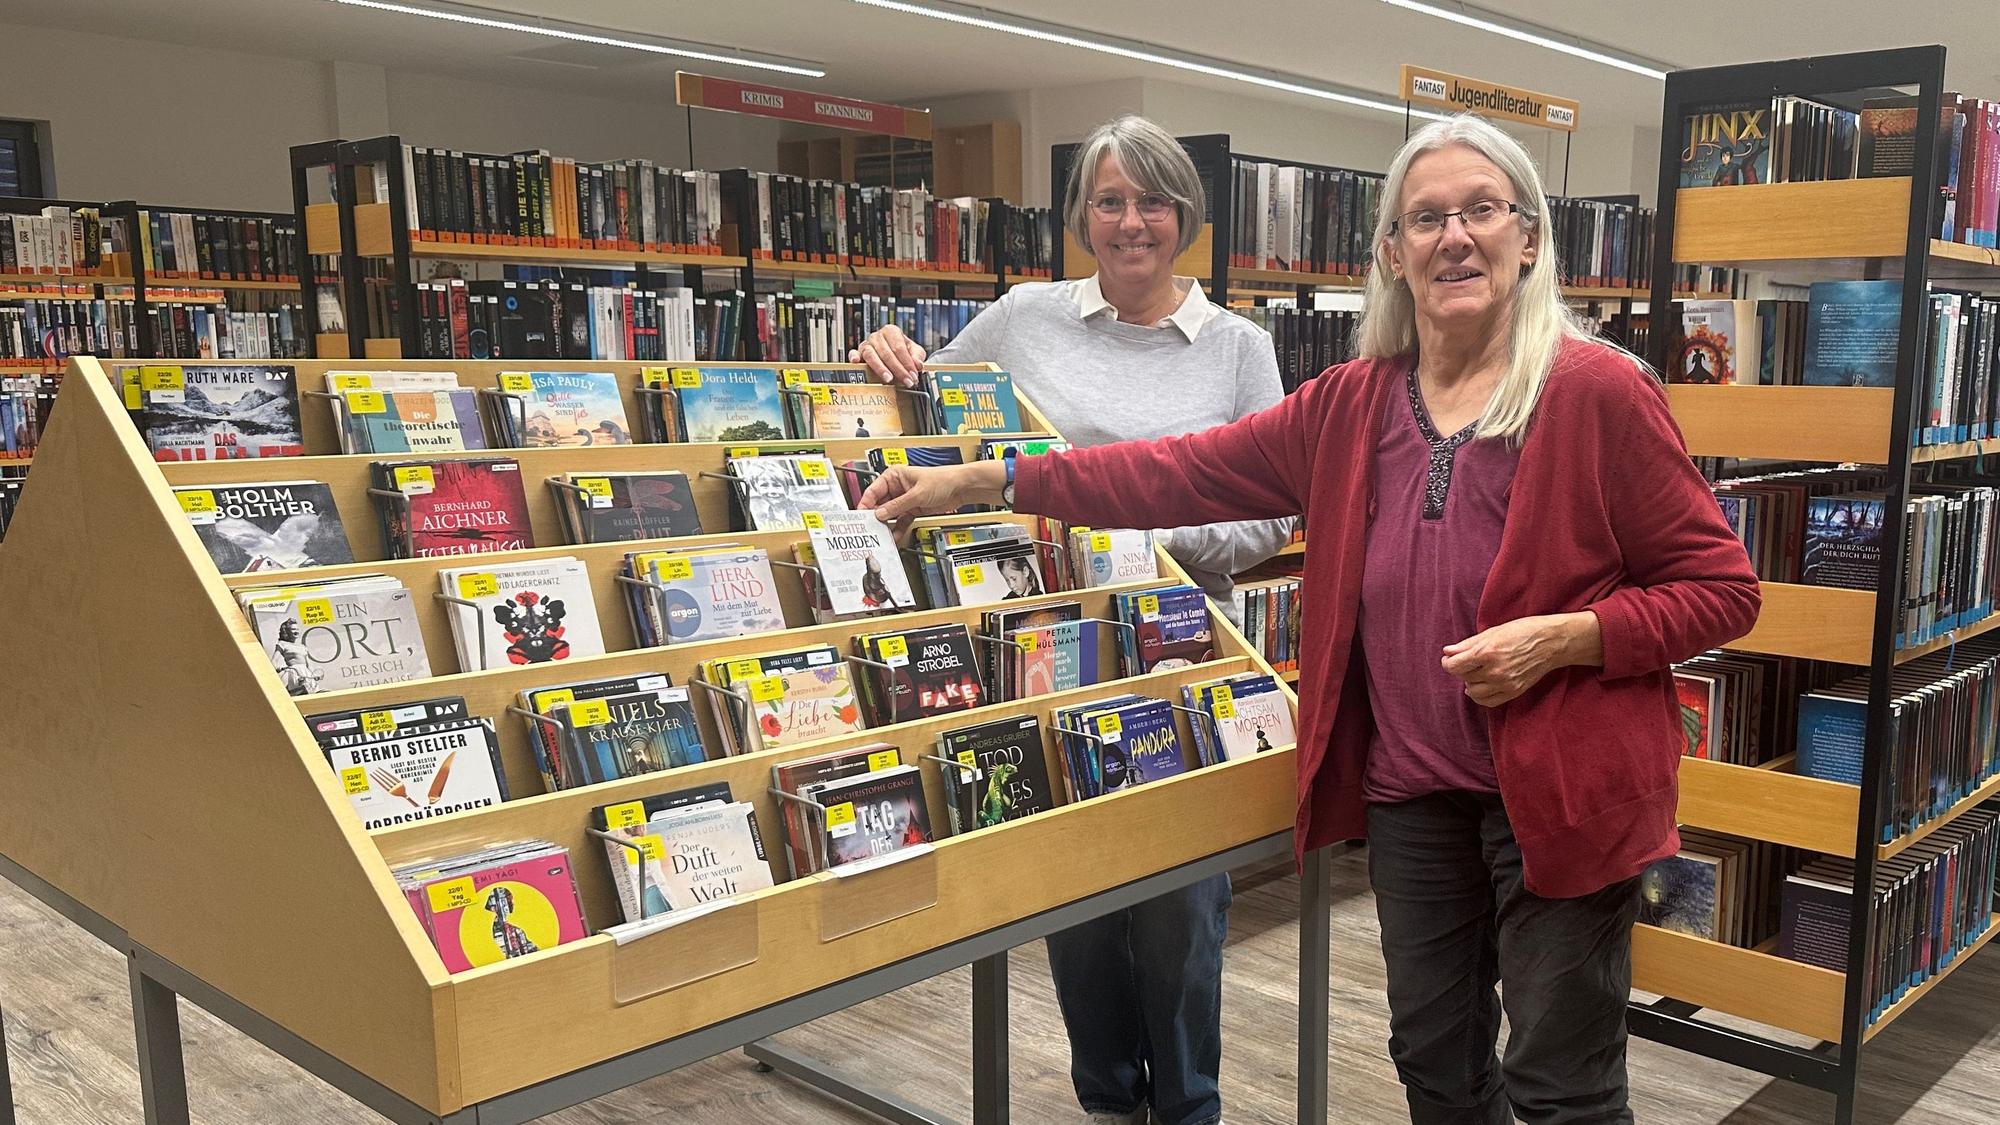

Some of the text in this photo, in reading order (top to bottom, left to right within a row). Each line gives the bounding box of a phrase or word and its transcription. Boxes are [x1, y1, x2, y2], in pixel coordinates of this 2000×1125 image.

[1414, 79, 1445, 96] FANTASY
[743, 92, 782, 108] KRIMIS
[1449, 80, 1542, 119] Jugendliteratur
[815, 103, 872, 121] SPANNUNG
[1547, 107, 1573, 122] FANTASY
[1681, 109, 1766, 162] JINX
[518, 197, 528, 217] DIE
[187, 372, 254, 384] RUTH WARE
[558, 376, 595, 391] PAULY
[700, 373, 727, 385] Dora
[729, 372, 758, 385] Heldt
[555, 402, 585, 410] WASSER
[861, 394, 892, 406] LARK
[976, 393, 998, 409] MAL
[413, 411, 431, 420] Die
[556, 409, 573, 417] SIND
[726, 413, 749, 421] Leben
[963, 411, 1005, 430] DAUMEN
[384, 421, 465, 432] theoretische
[214, 433, 237, 447] DAS
[226, 488, 293, 505] HOLM
[214, 501, 316, 521] BOLTHER
[434, 500, 491, 513] BERNHARD
[422, 511, 511, 531] AICHNER
[828, 523, 866, 536] RICHTER
[826, 534, 881, 551] MORDEN
[1819, 542, 1880, 553] DER HERZSCHLA
[841, 550, 873, 562] BESSER
[1122, 552, 1148, 564] NINA
[1823, 550, 1881, 561] DER DICH RUFT
[712, 567, 754, 583] HERA
[1118, 562, 1155, 578] GEORGE
[510, 577, 560, 589] LAGERCRANTZ
[710, 581, 764, 602] LIND
[335, 602, 368, 619] EIN
[671, 608, 699, 619] argon
[712, 600, 759, 612] Mit dem Mut
[752, 607, 772, 617] Liebe
[1046, 627, 1072, 637] PETRA
[301, 617, 413, 664] ORT,
[1036, 636, 1081, 650] HÜLSMANN
[922, 642, 951, 659] ARNO
[341, 659, 404, 679] DER SICH
[917, 655, 963, 673] STROBEL
[921, 683, 976, 708] FAKE
[434, 703, 459, 716] DAV
[609, 699, 666, 725] NIELS
[798, 699, 811, 710] Die
[1236, 703, 1275, 718] ACHTSAM
[783, 701, 835, 733] Liebe
[1234, 713, 1282, 733] MORDEN
[588, 718, 683, 743] KRAUSE-KJÆR
[797, 726, 827, 738] braucht
[969, 729, 1032, 750] ANDREAS GRUBER
[1130, 724, 1176, 762] PANDORA
[350, 733, 468, 765] BERND STELTER
[391, 761, 405, 769] LIEST
[979, 745, 1023, 773] TOD
[1009, 778, 1033, 801] ES
[856, 800, 895, 836] TAG
[680, 843, 700, 854] Der
[870, 835, 894, 856] DER
[671, 847, 720, 875] Duft
[473, 868, 518, 884] EMI YAGI
[692, 863, 743, 882] der weiten
[689, 877, 738, 904] Welt
